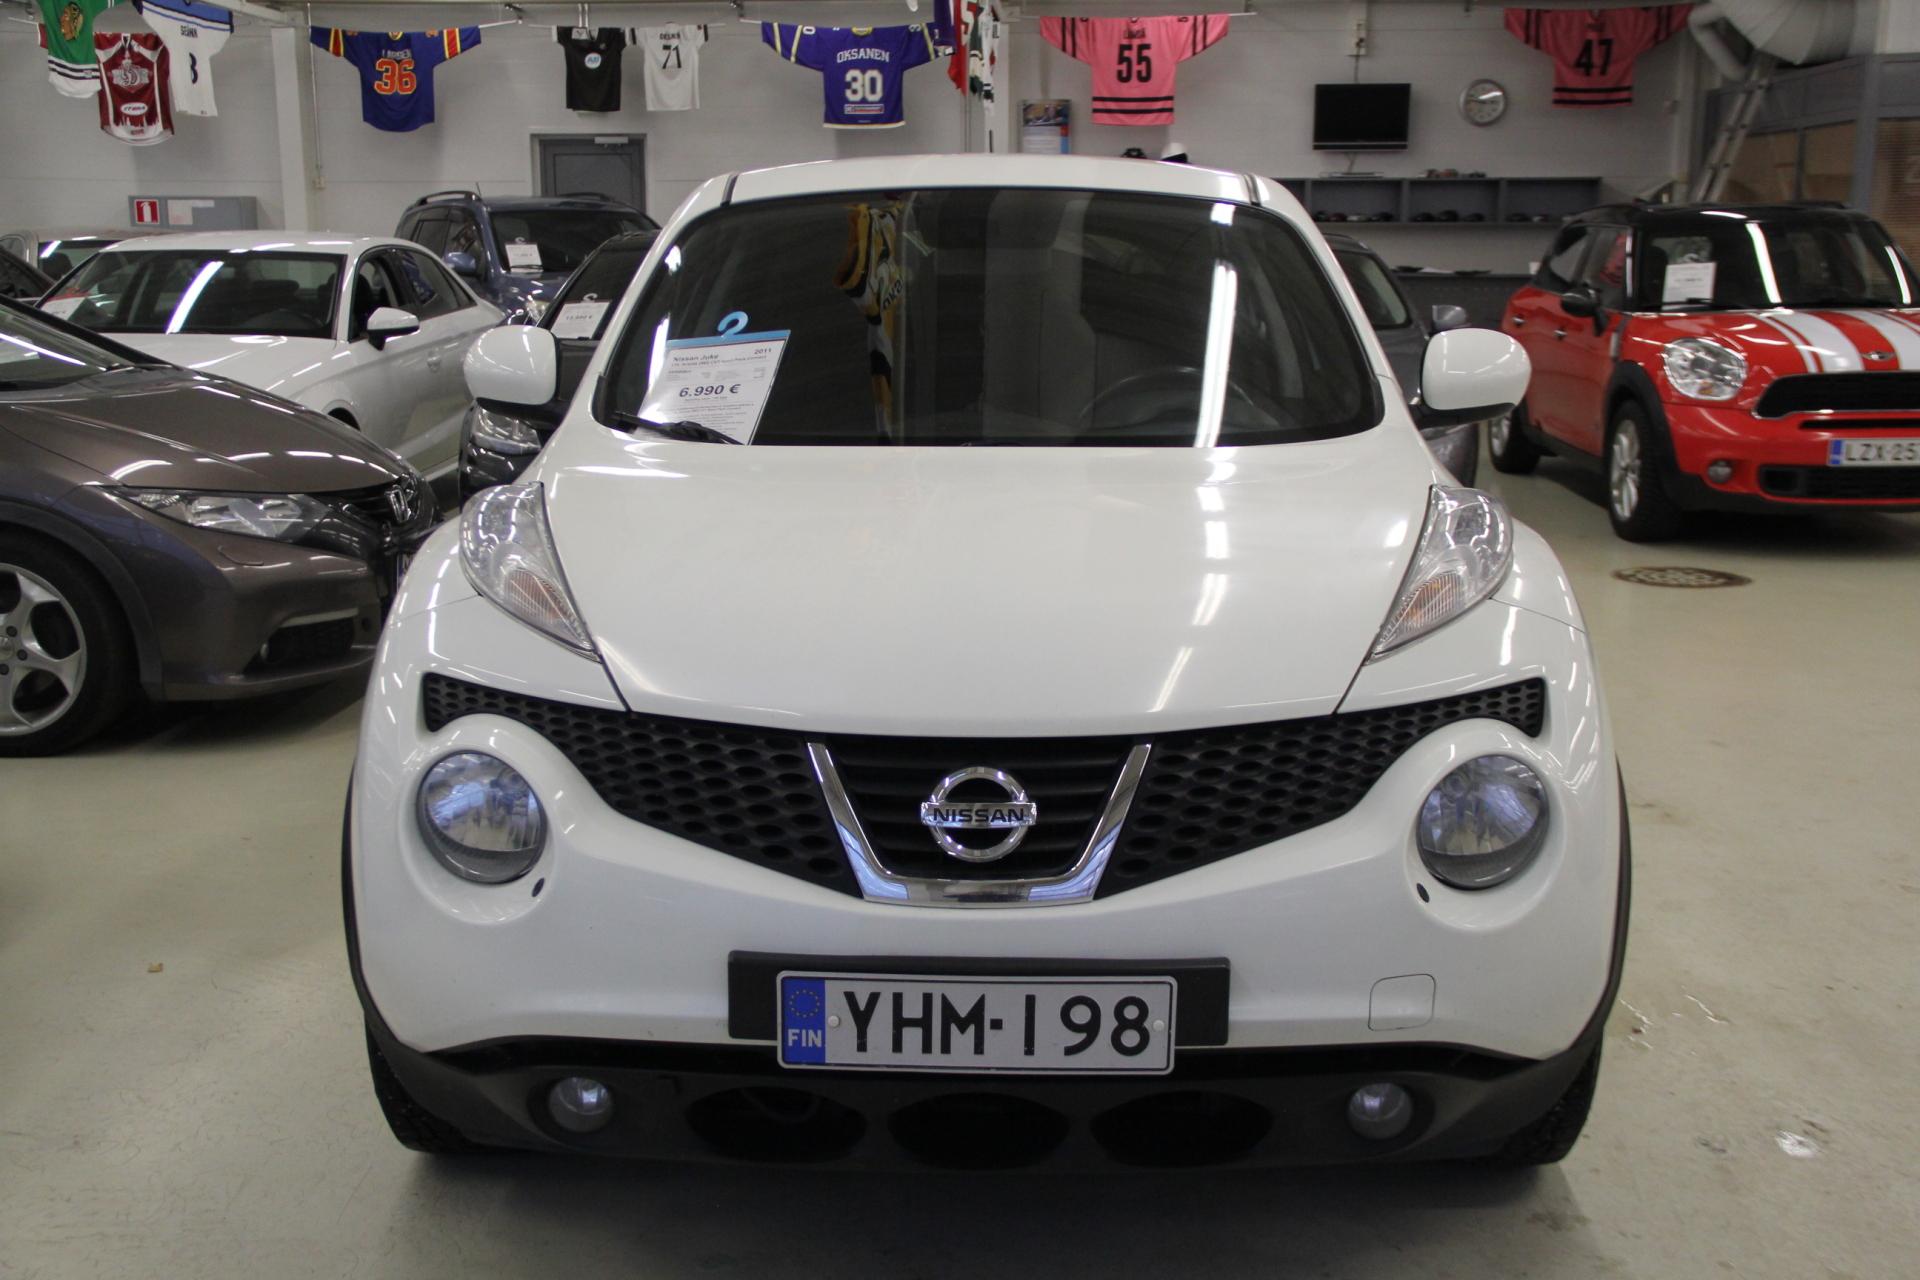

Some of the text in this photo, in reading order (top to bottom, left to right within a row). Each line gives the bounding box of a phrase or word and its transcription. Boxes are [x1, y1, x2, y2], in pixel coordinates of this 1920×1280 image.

[661, 44, 682, 69] 71
[837, 48, 890, 64] OKSANEN
[1117, 43, 1152, 83] 55
[1575, 39, 1613, 77] 47
[374, 58, 417, 95] 36
[845, 69, 884, 102] 30
[679, 383, 741, 398] 6.990 €
[1846, 442, 1920, 461] LZX-25
[933, 808, 1024, 823] NISSAN
[843, 991, 1151, 1057] YHM-198
[787, 1029, 822, 1048] FIN
